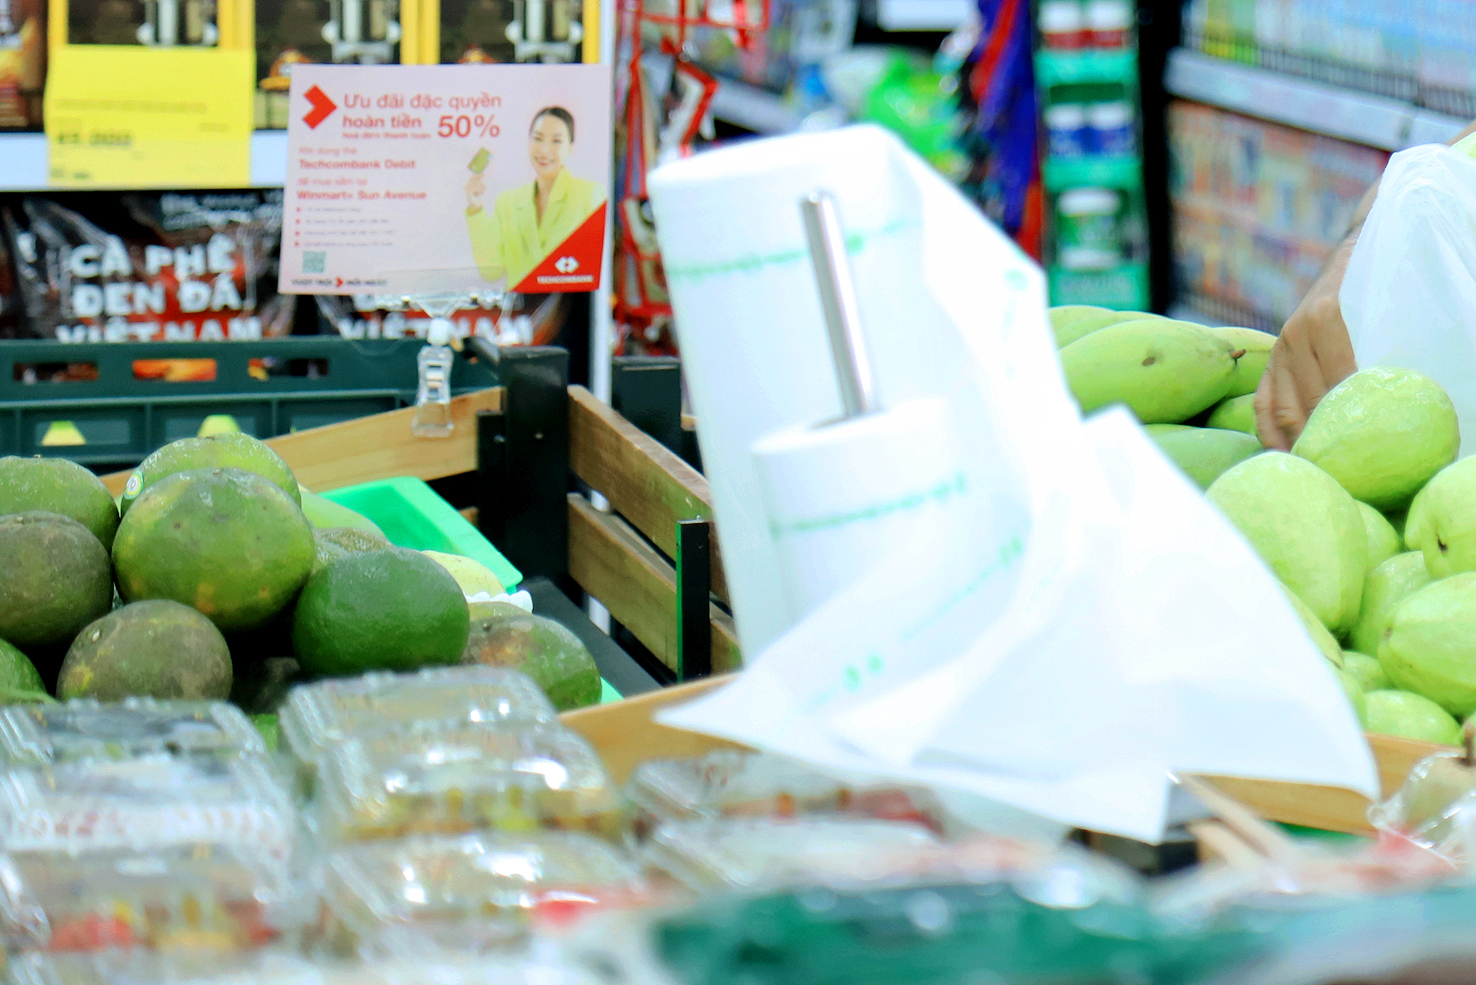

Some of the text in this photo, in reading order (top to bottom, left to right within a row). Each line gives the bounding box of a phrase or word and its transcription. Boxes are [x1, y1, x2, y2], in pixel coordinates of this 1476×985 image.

[343, 91, 502, 112] Ưu đãi đặc quyền
[342, 112, 422, 129] hoàn tiền
[437, 113, 501, 139] 50%
[298, 158, 380, 169] Techcombank
